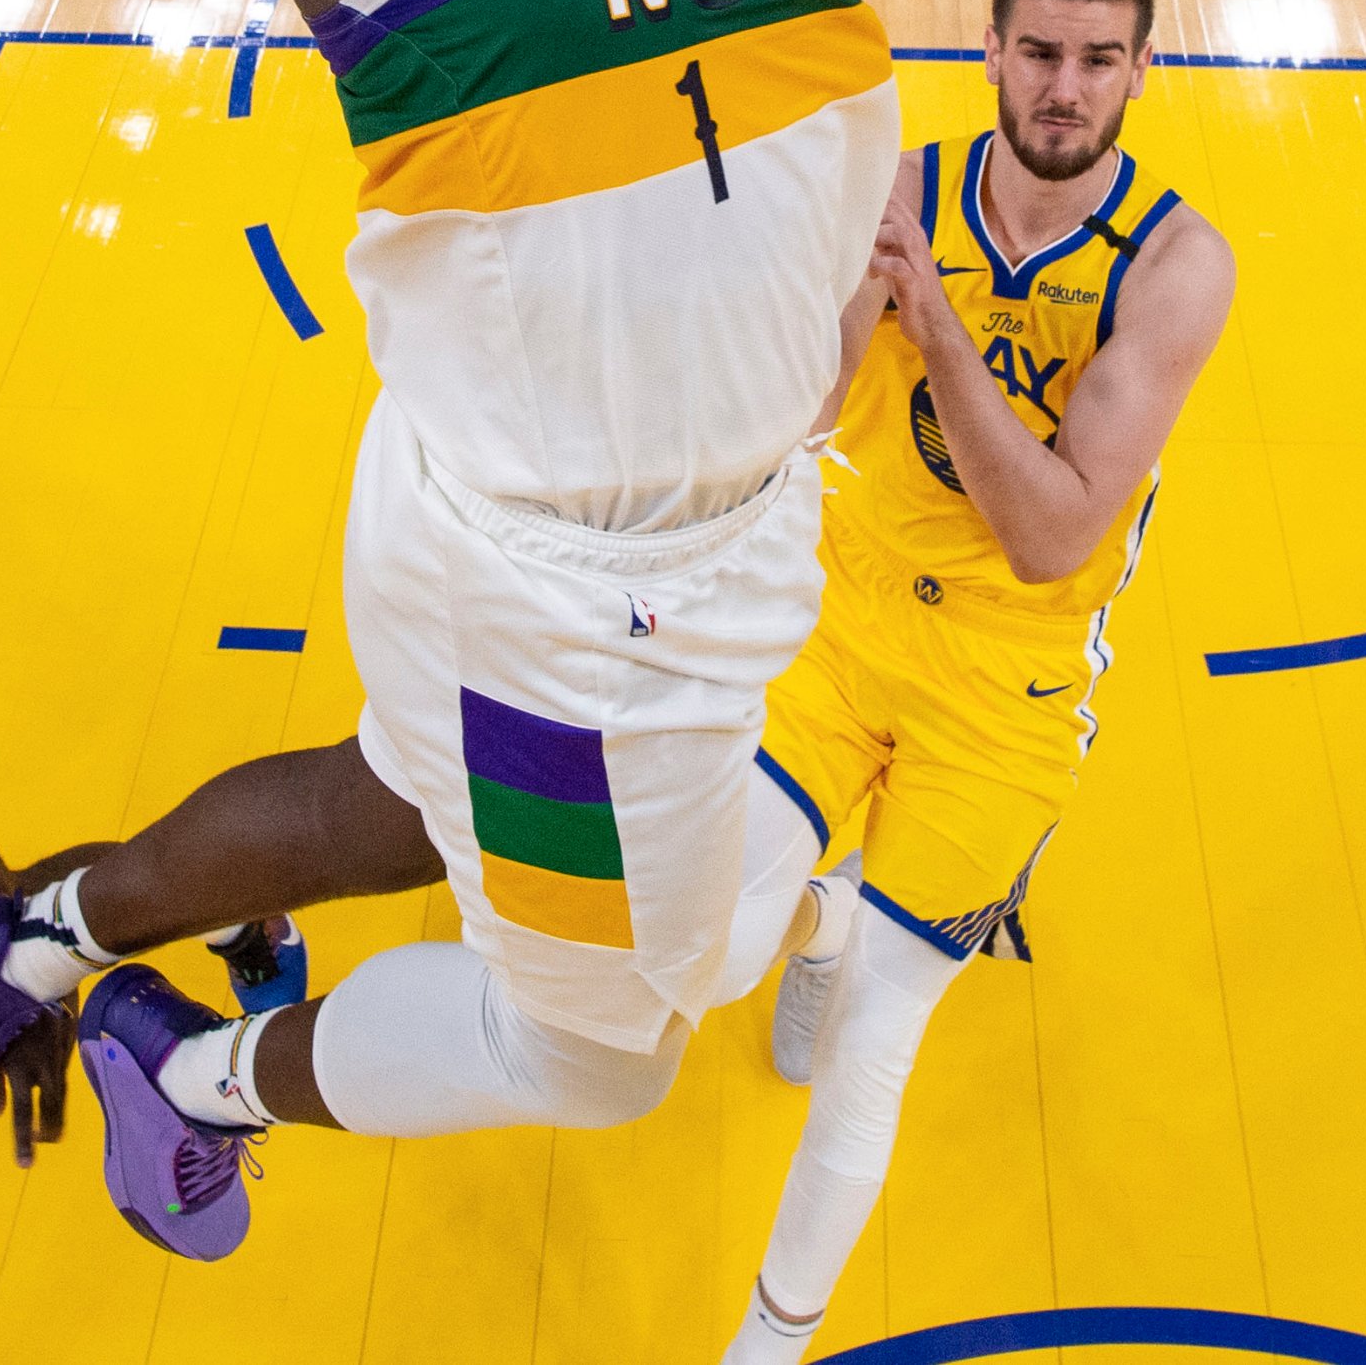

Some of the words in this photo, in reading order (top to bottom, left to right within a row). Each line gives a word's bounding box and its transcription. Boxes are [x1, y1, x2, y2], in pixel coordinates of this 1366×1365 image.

[675, 59, 731, 204] 1
[1037, 280, 1100, 305] Rakuten
[982, 311, 1025, 334] The
[982, 334, 1068, 400] AY
